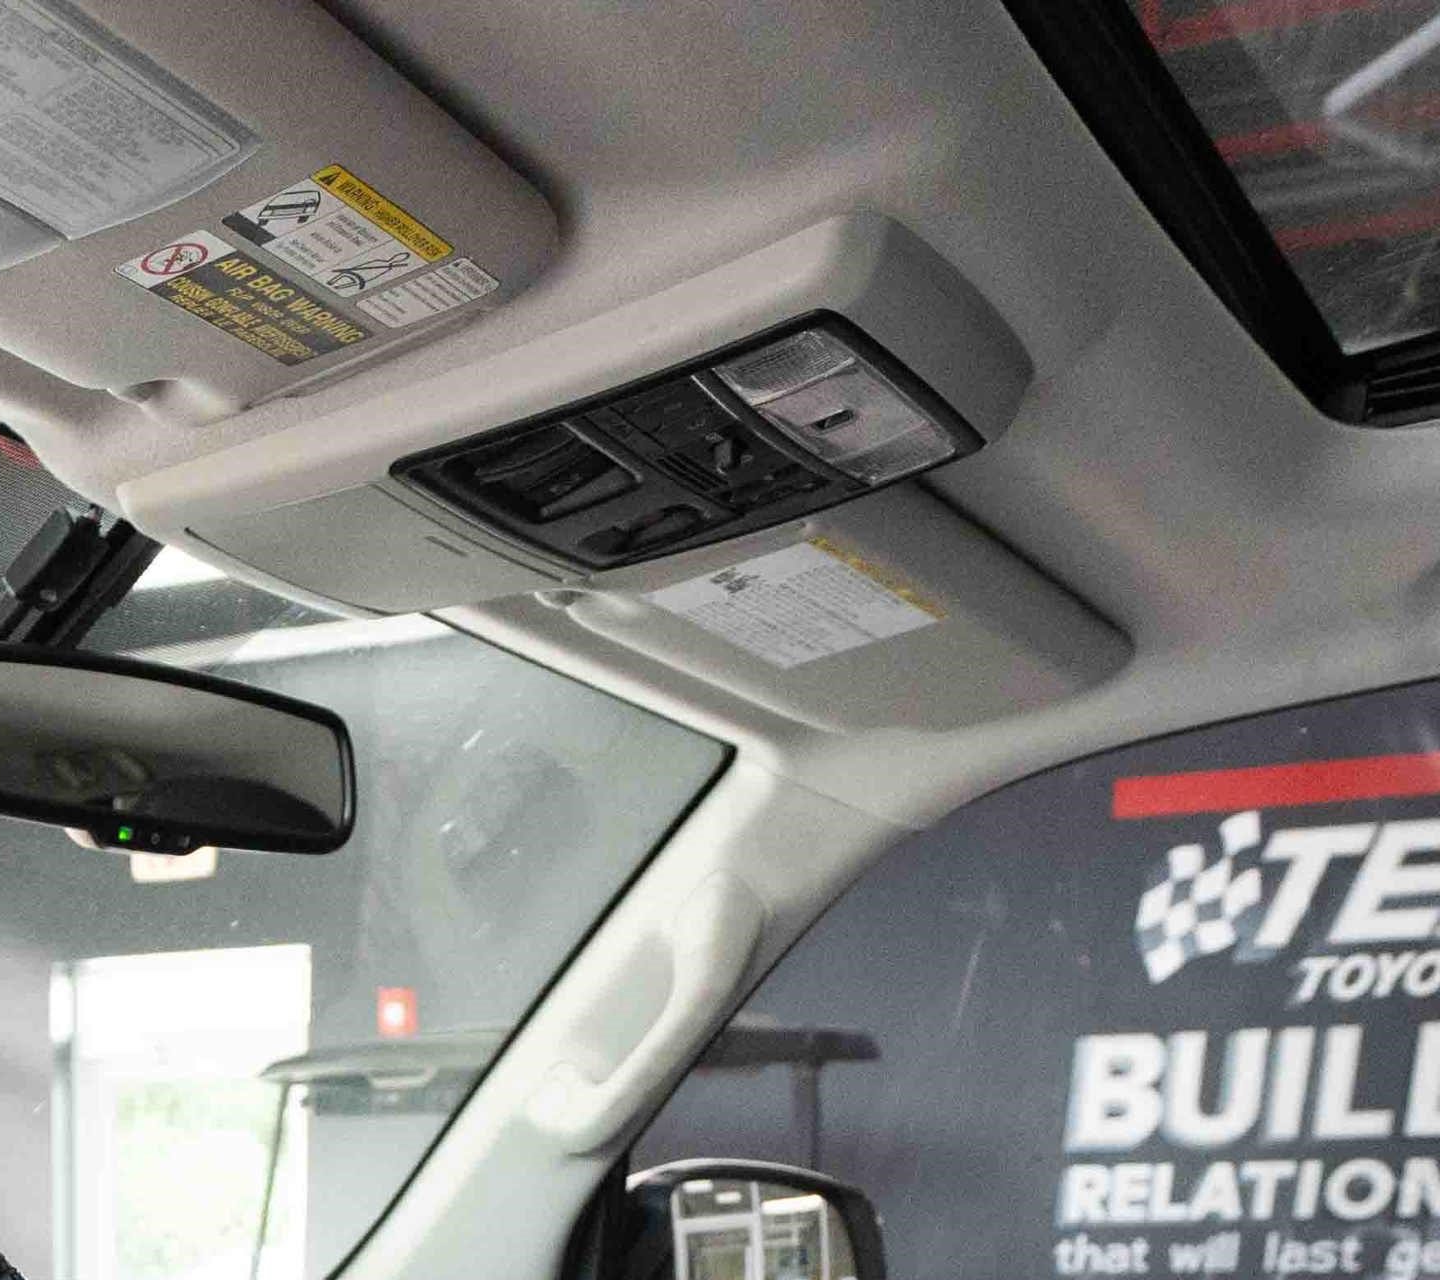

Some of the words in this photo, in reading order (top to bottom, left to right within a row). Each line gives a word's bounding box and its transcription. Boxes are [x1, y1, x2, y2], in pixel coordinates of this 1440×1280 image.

[214, 258, 258, 281] AIR
[247, 275, 296, 302] BAG
[287, 295, 365, 344] WARNING
[1055, 1232, 1151, 1275] that
[1169, 1232, 1242, 1273] will
[1262, 1230, 1363, 1274] last
